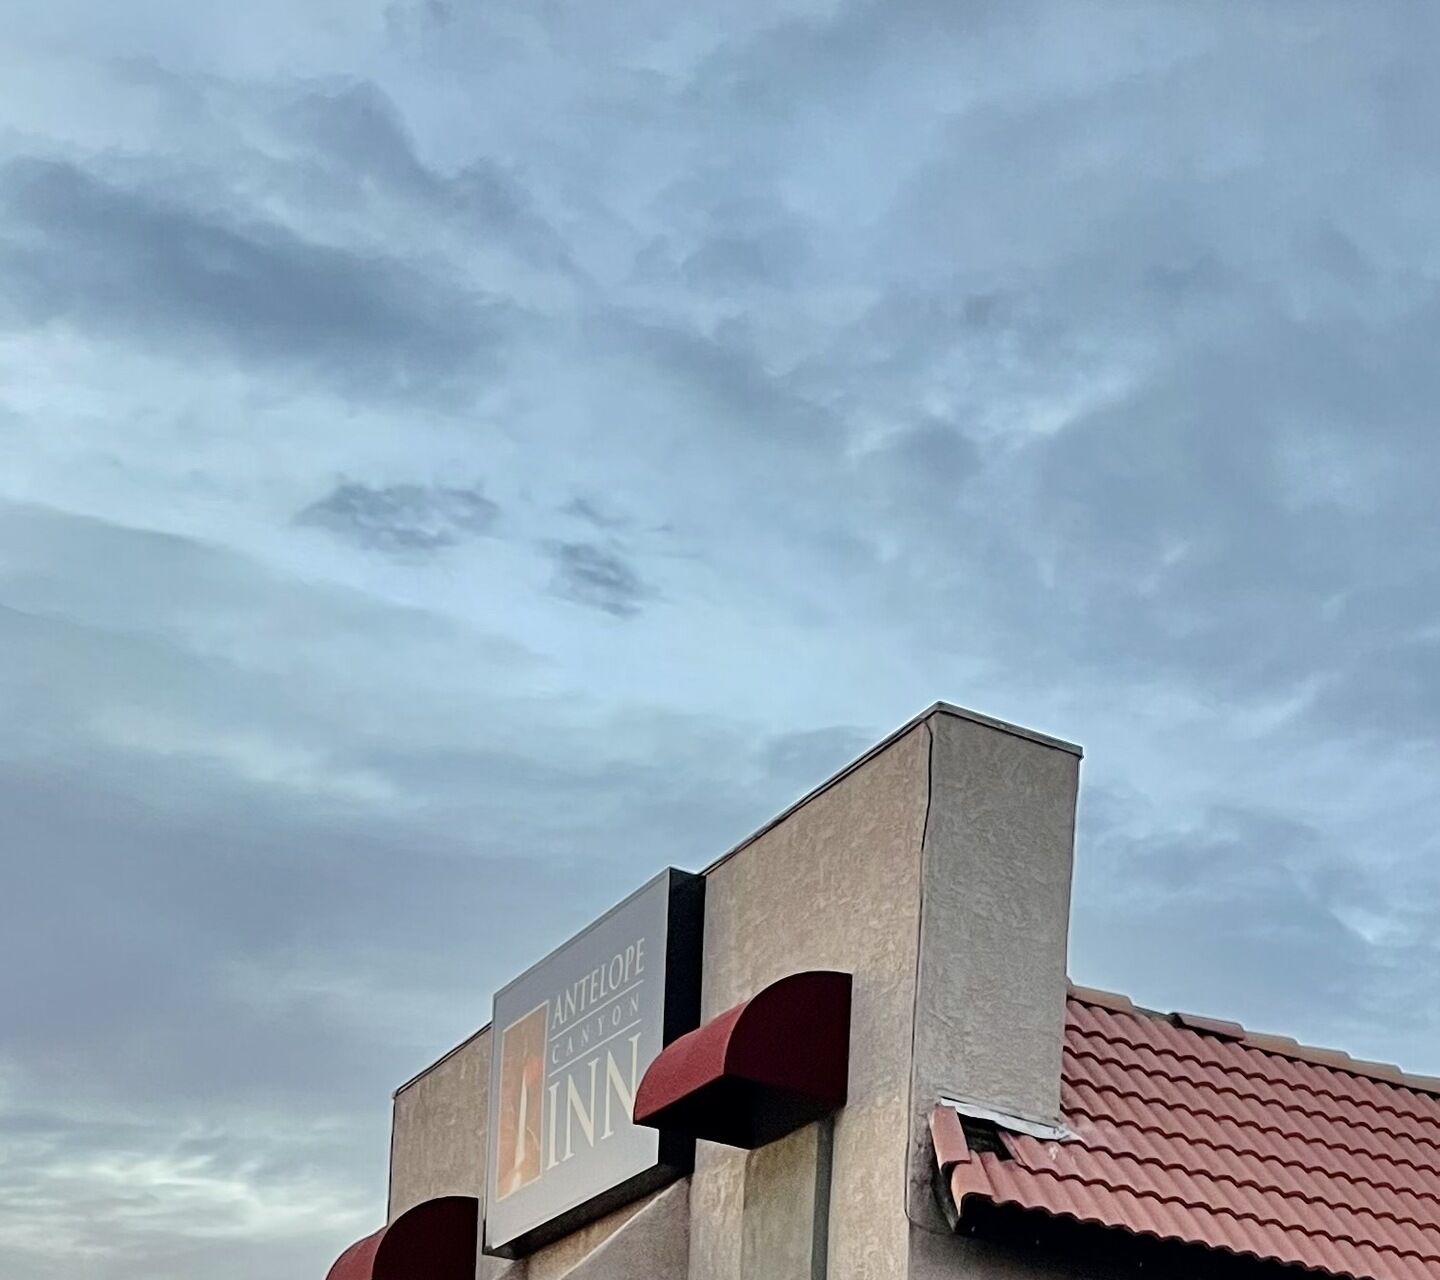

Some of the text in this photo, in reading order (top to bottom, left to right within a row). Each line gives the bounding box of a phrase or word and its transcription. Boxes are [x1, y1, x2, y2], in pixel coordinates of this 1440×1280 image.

[552, 937, 645, 1028] ANTELOPE
[552, 995, 640, 1063] CANYON
[546, 1033, 641, 1170] INN
